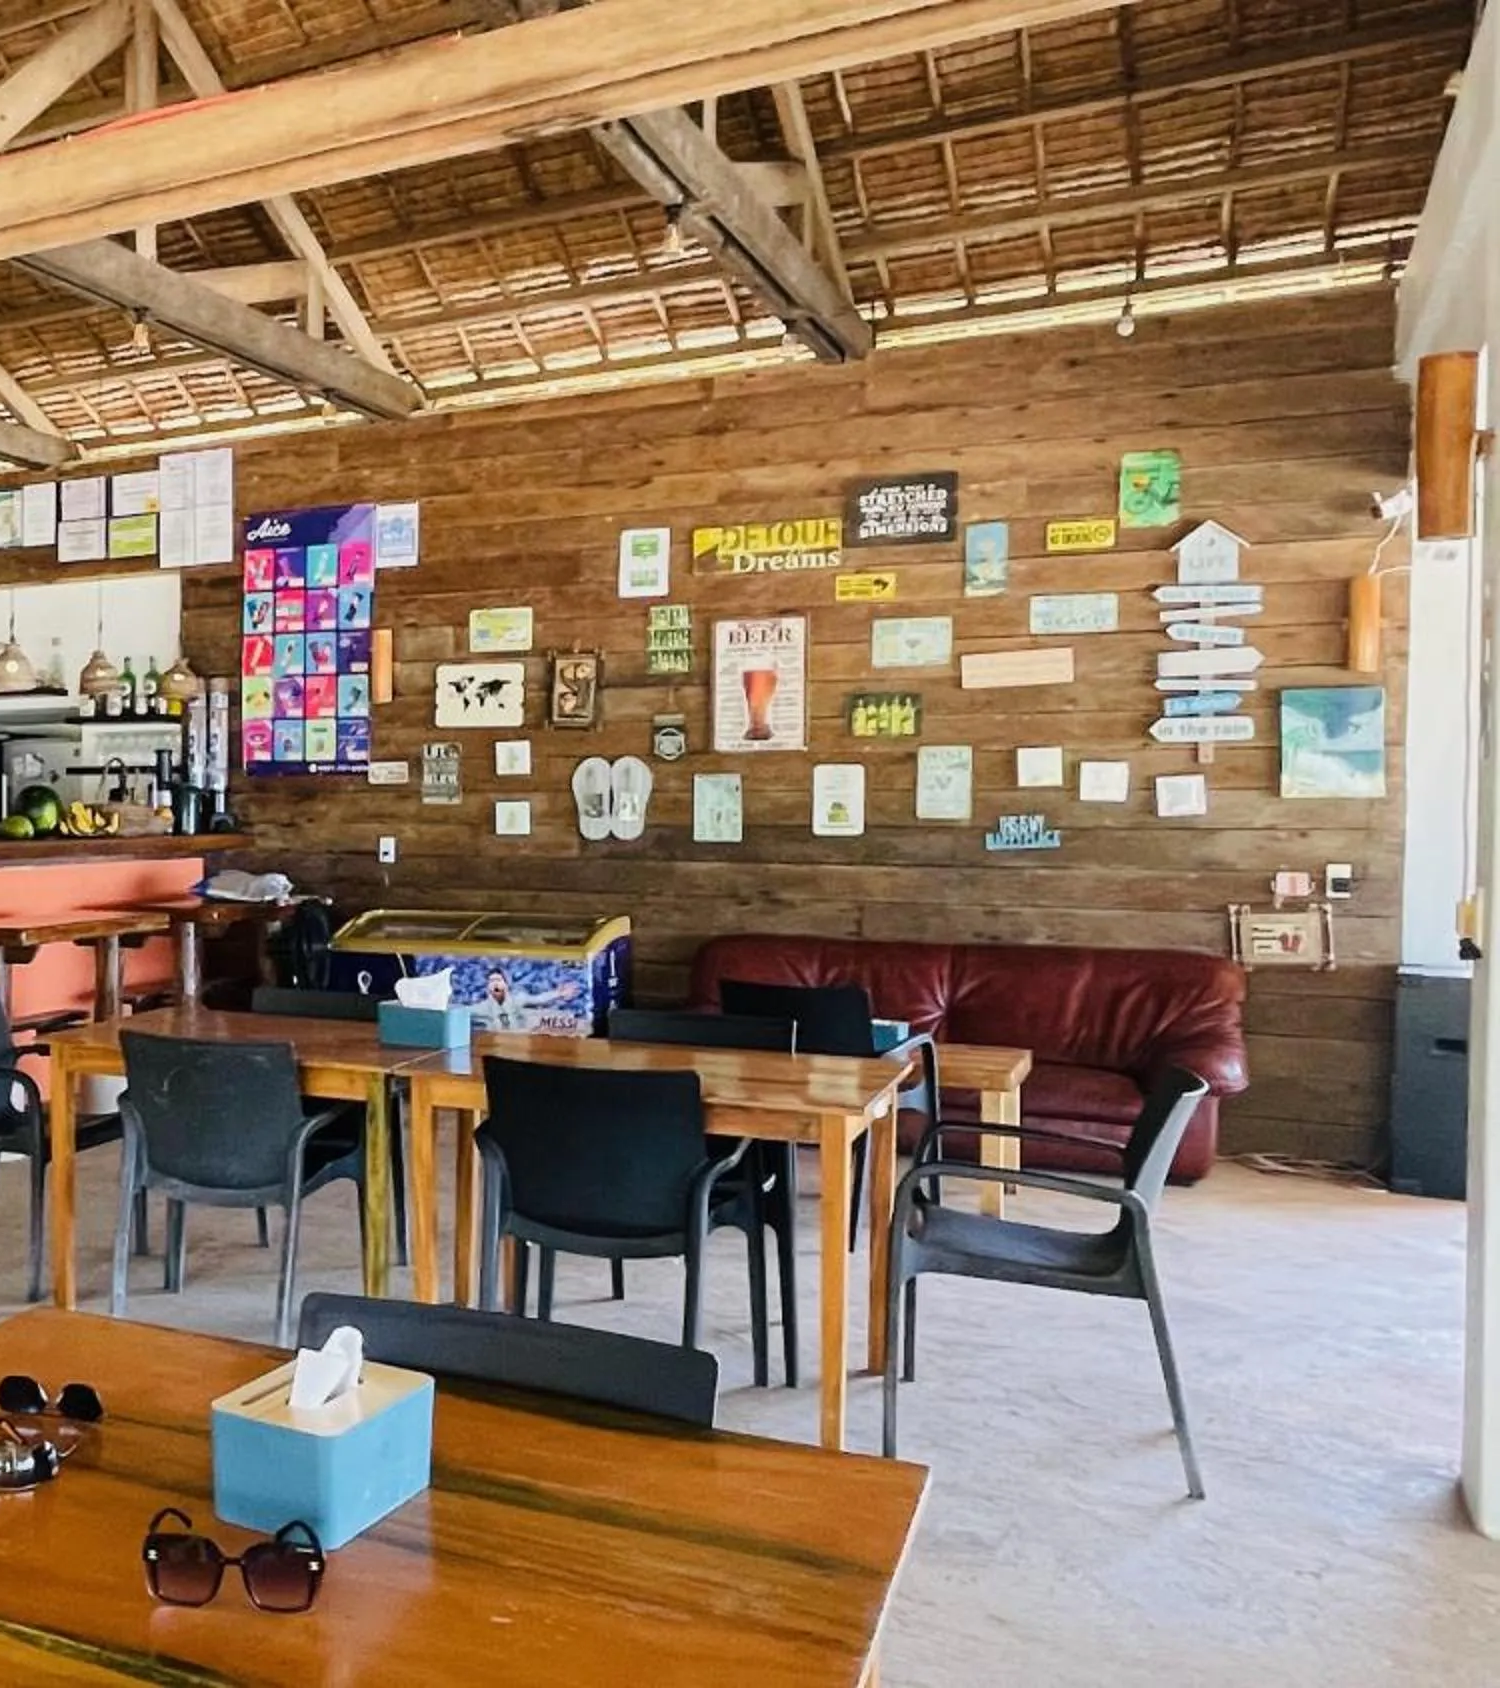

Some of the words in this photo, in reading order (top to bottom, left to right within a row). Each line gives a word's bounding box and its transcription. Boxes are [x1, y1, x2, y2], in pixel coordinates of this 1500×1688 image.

[246, 517, 292, 541] Aice
[722, 518, 838, 549] DETOUR
[733, 550, 841, 573] Dreams
[729, 627, 792, 645] BEER
